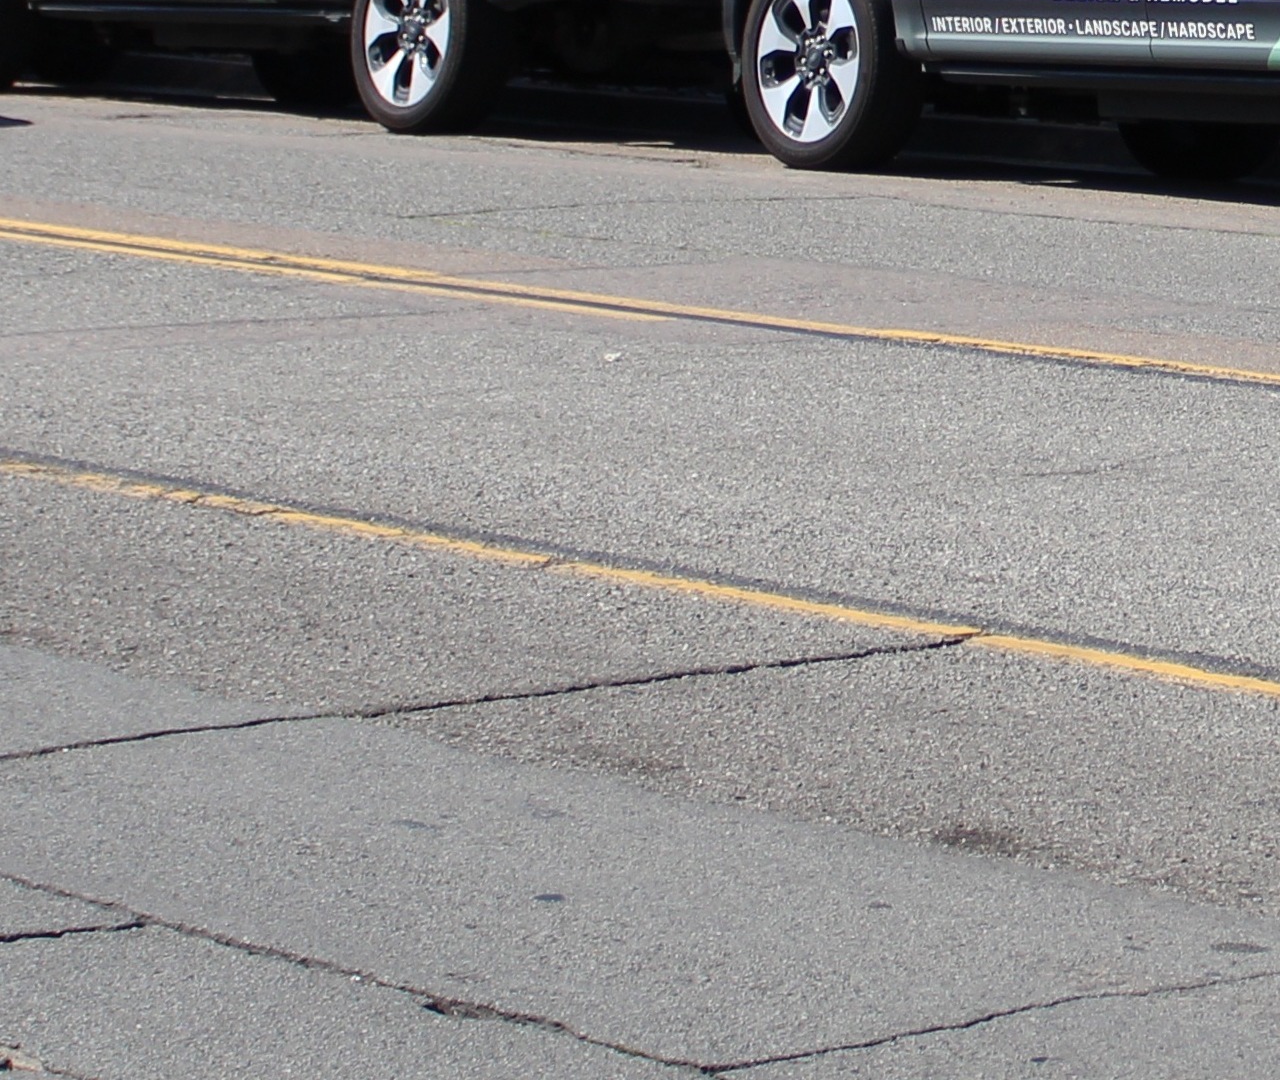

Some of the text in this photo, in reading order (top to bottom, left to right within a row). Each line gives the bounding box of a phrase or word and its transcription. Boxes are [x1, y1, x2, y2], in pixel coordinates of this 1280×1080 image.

[932, 16, 993, 34] INTERIOR
[1002, 18, 1067, 35] EXTERIOR
[1076, 19, 1157, 38] LANDSCAPE
[1168, 22, 1255, 40] HARDSCAPE
